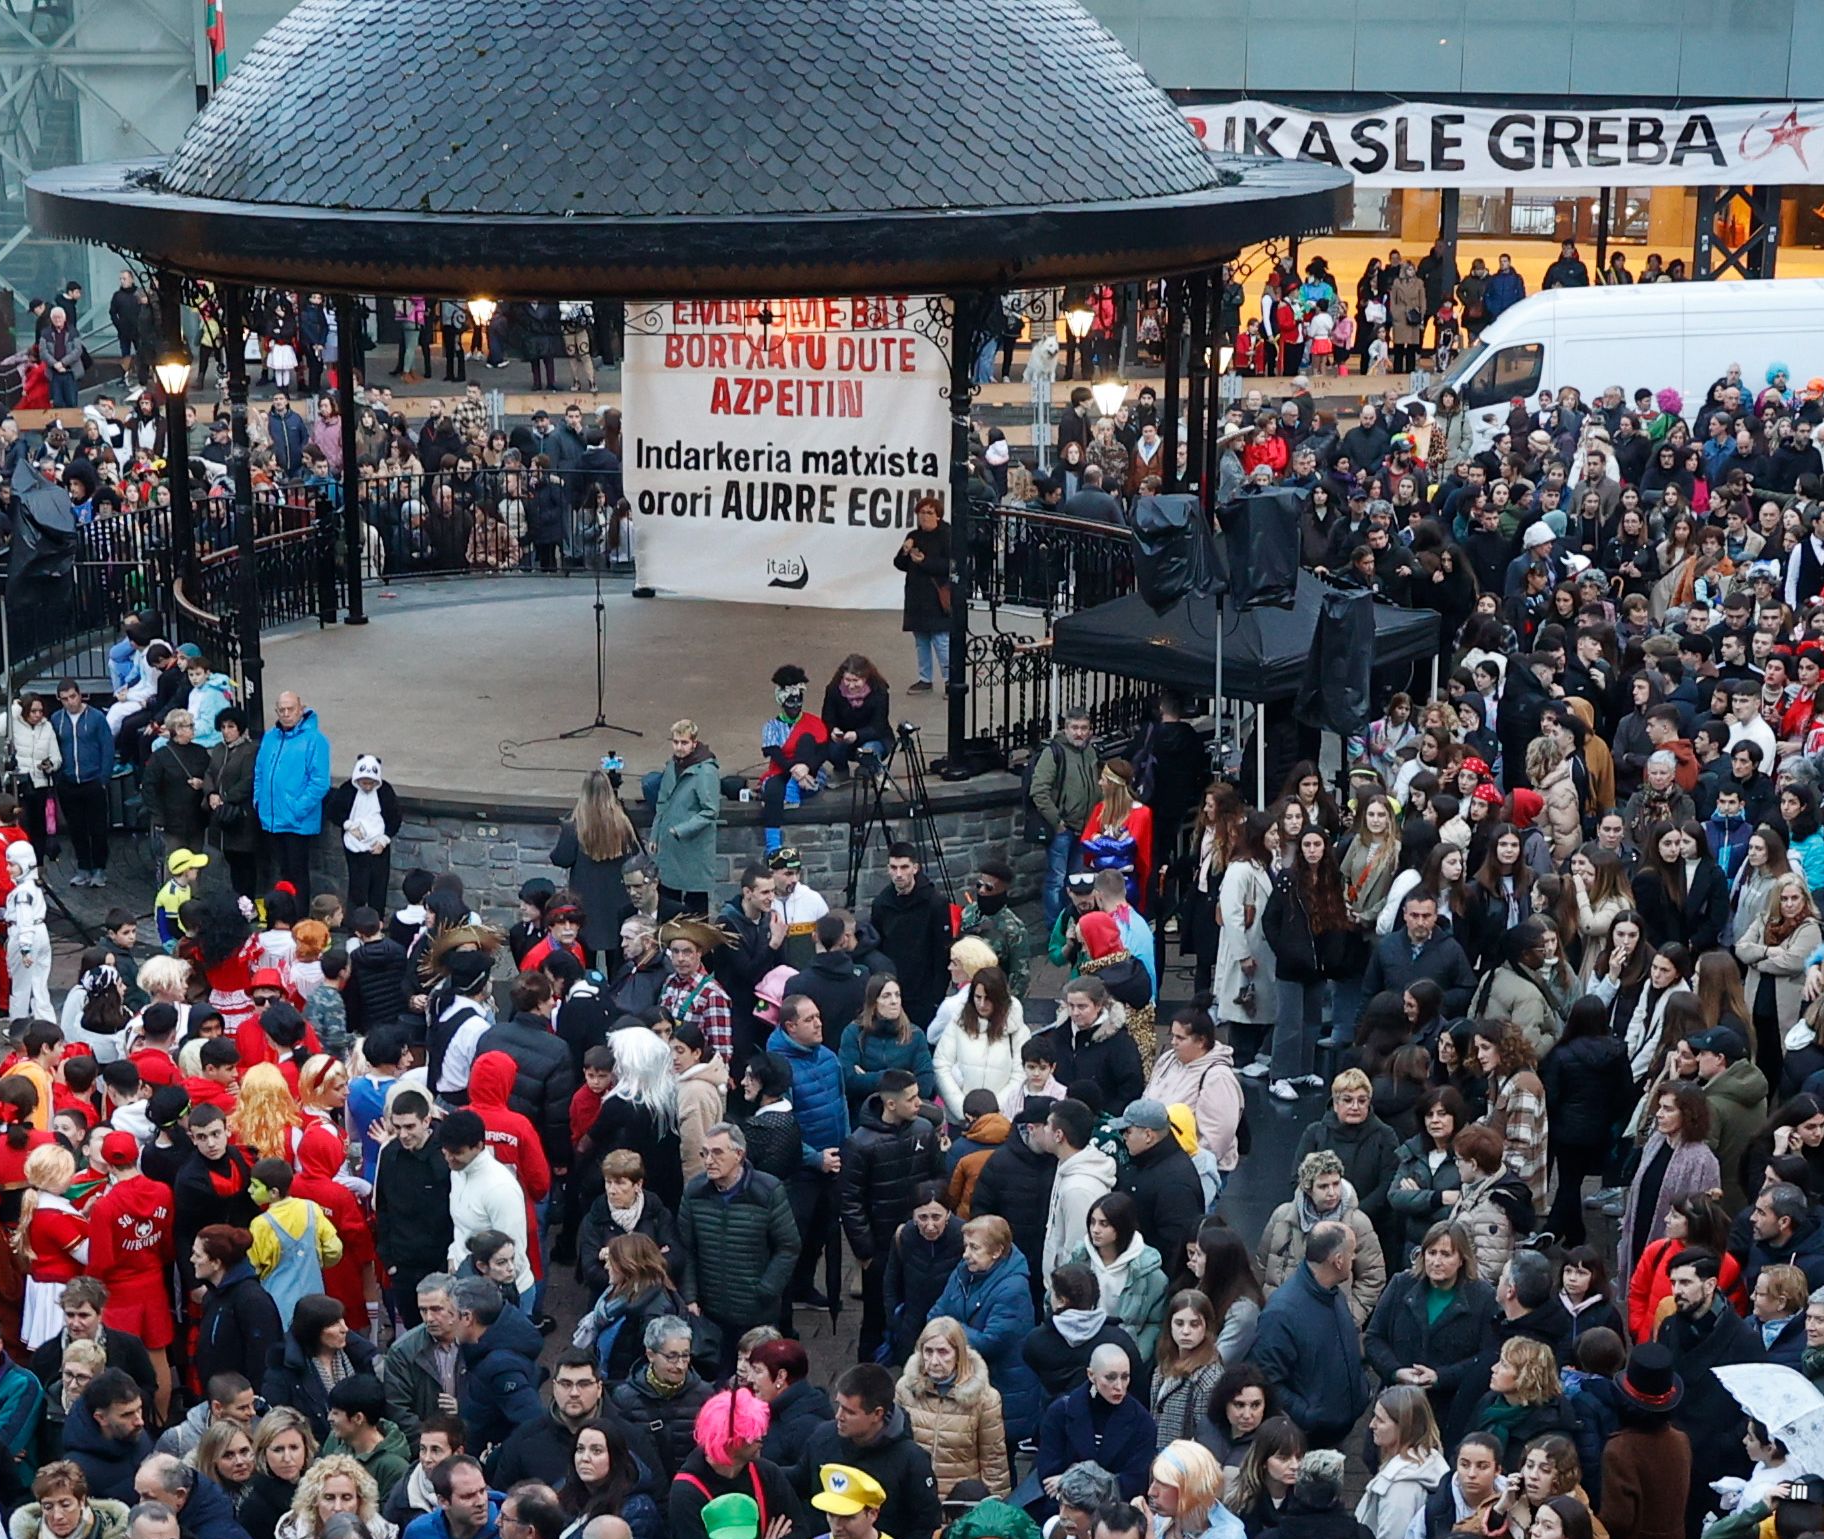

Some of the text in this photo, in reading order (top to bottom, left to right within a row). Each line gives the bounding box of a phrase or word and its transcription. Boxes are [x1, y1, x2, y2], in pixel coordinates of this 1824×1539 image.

[1223, 114, 1466, 173] IKASLE
[1487, 113, 1727, 171] GREBA
[851, 296, 908, 329] BAT
[664, 334, 917, 372] BORTXATU DUTE
[710, 376, 864, 418] AZPEITIN
[636, 437, 938, 478] Indarkeria matxista
[638, 486, 712, 517] orori
[721, 480, 837, 524] AURRE
[766, 558, 800, 576] itaia
